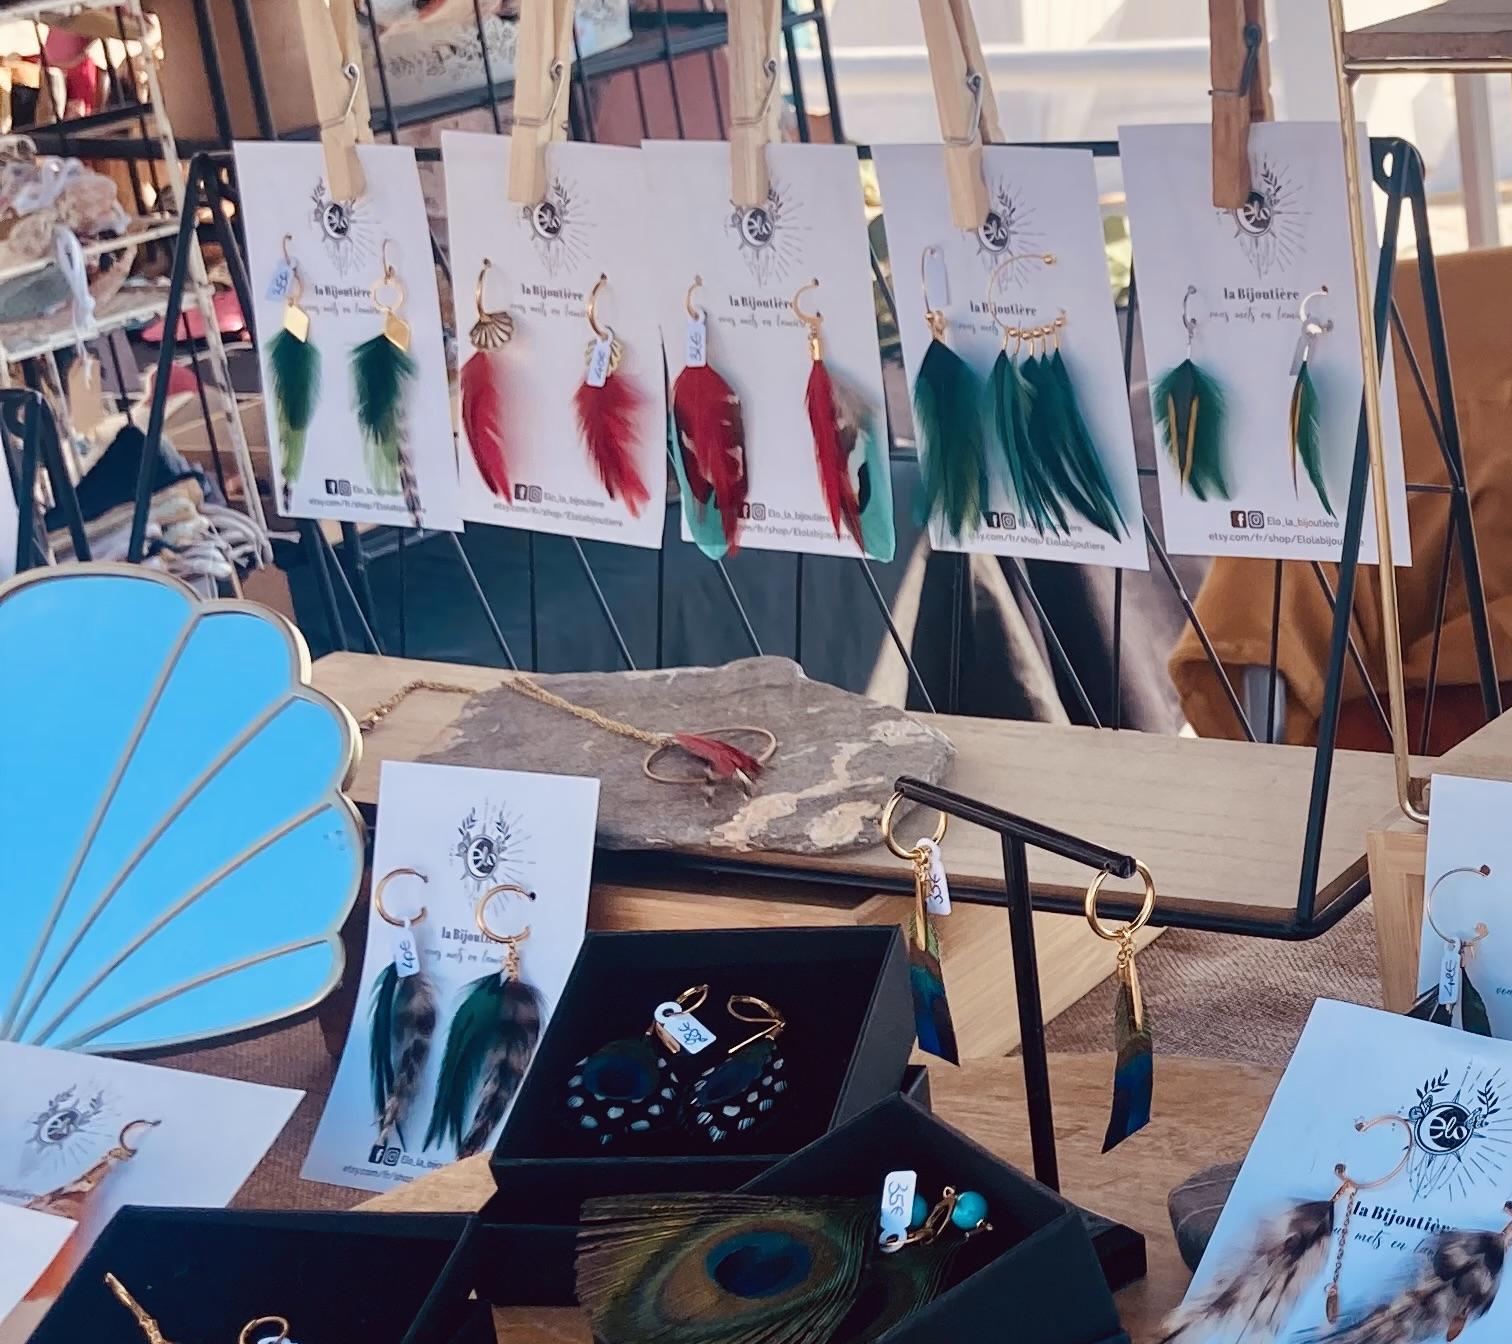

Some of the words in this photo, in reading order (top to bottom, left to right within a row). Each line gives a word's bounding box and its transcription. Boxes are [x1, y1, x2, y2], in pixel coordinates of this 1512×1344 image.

[453, 928, 499, 944] Bijout
[888, 1181, 908, 1216] 35€
[1352, 1200, 1369, 1217] la
